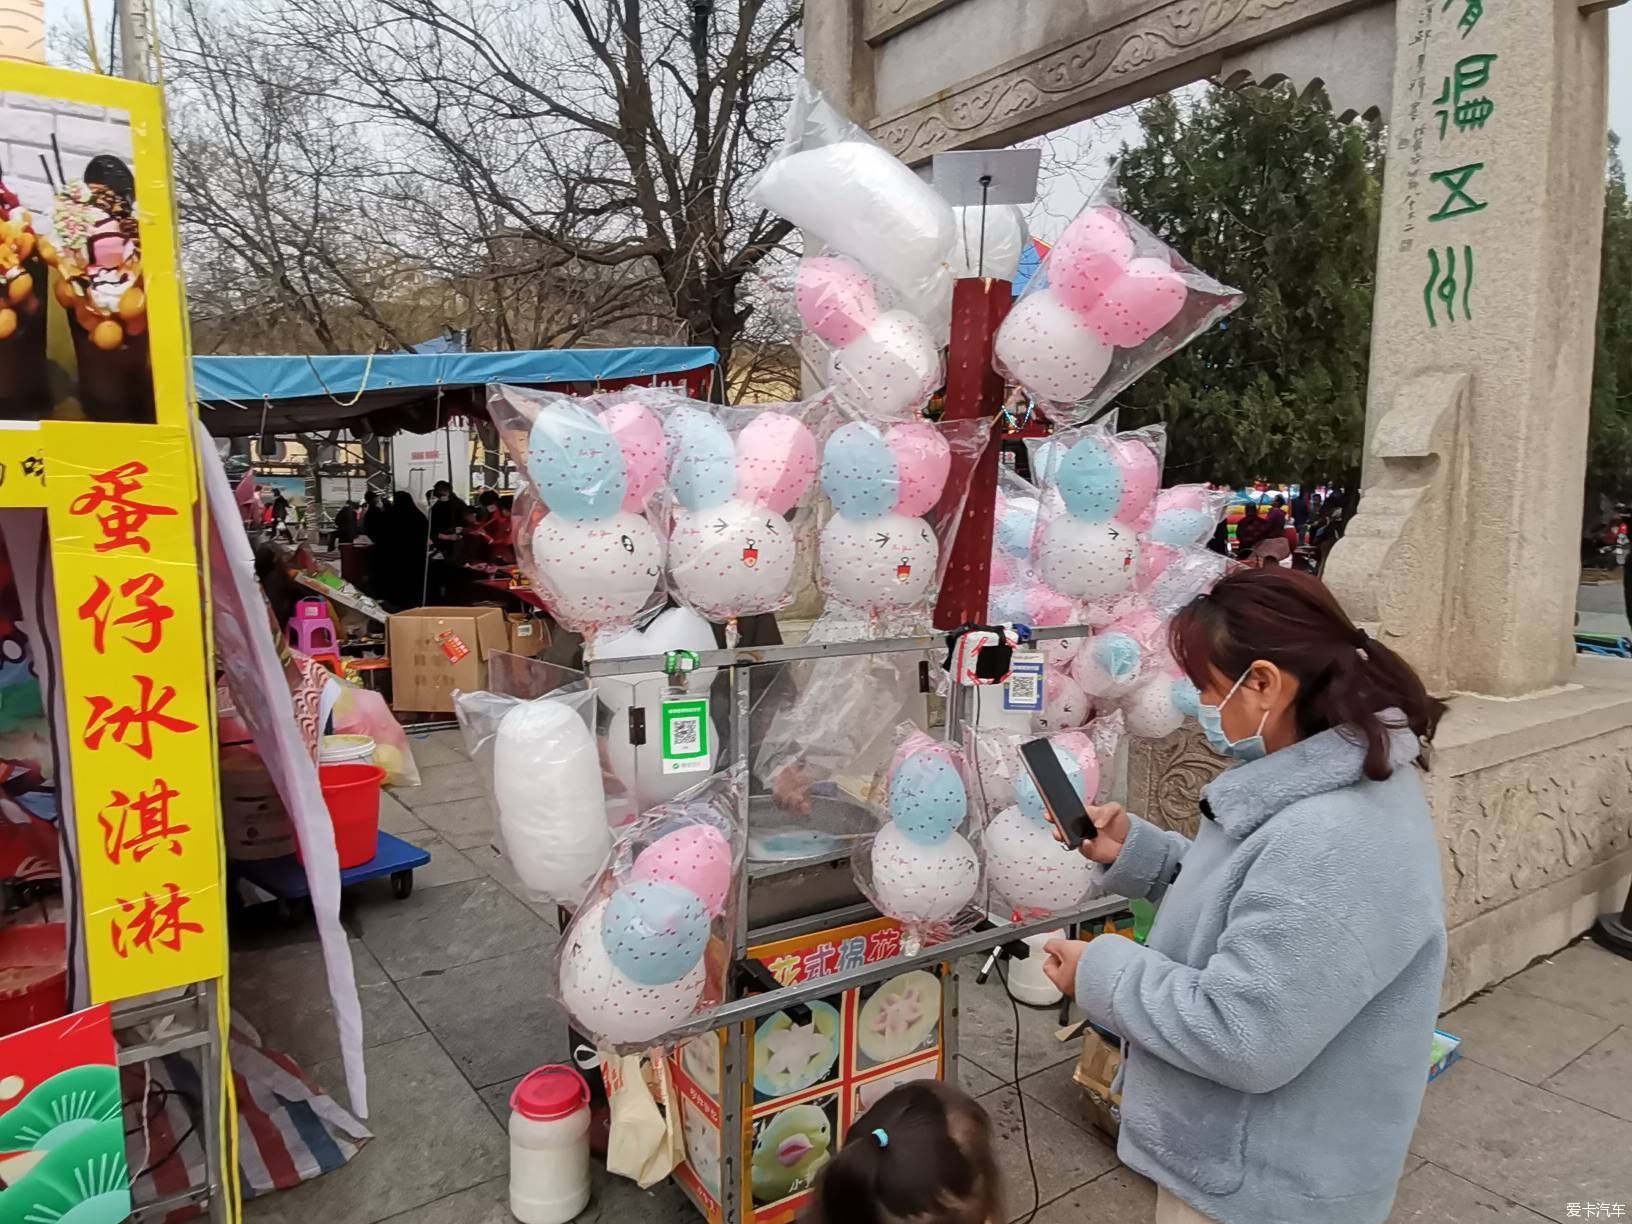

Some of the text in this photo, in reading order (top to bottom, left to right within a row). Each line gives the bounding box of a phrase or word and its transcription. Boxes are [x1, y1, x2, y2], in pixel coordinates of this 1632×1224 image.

[69, 461, 204, 960] 蛋仔冰淇淋
[767, 927, 919, 987] 花式棉花
